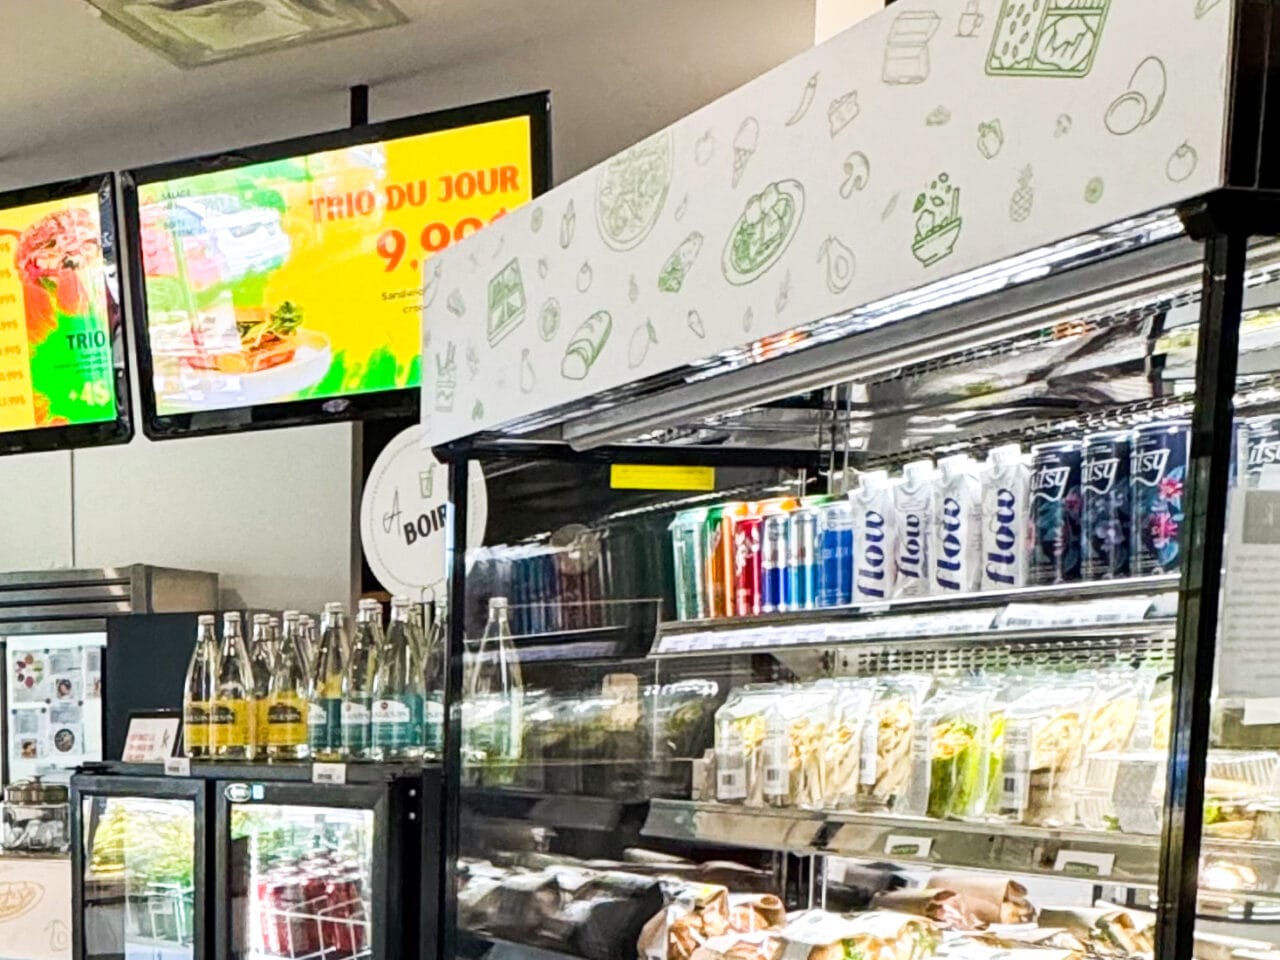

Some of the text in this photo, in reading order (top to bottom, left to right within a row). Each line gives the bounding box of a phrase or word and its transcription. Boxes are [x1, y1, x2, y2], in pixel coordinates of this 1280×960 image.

[308, 165, 519, 223] TRIO DU JOUR
[66, 330, 106, 350] TRIO
[403, 503, 447, 546] BOIR
[857, 510, 885, 598] flow
[894, 513, 921, 579] flow
[936, 497, 961, 591] flow
[985, 488, 1015, 585] flow
